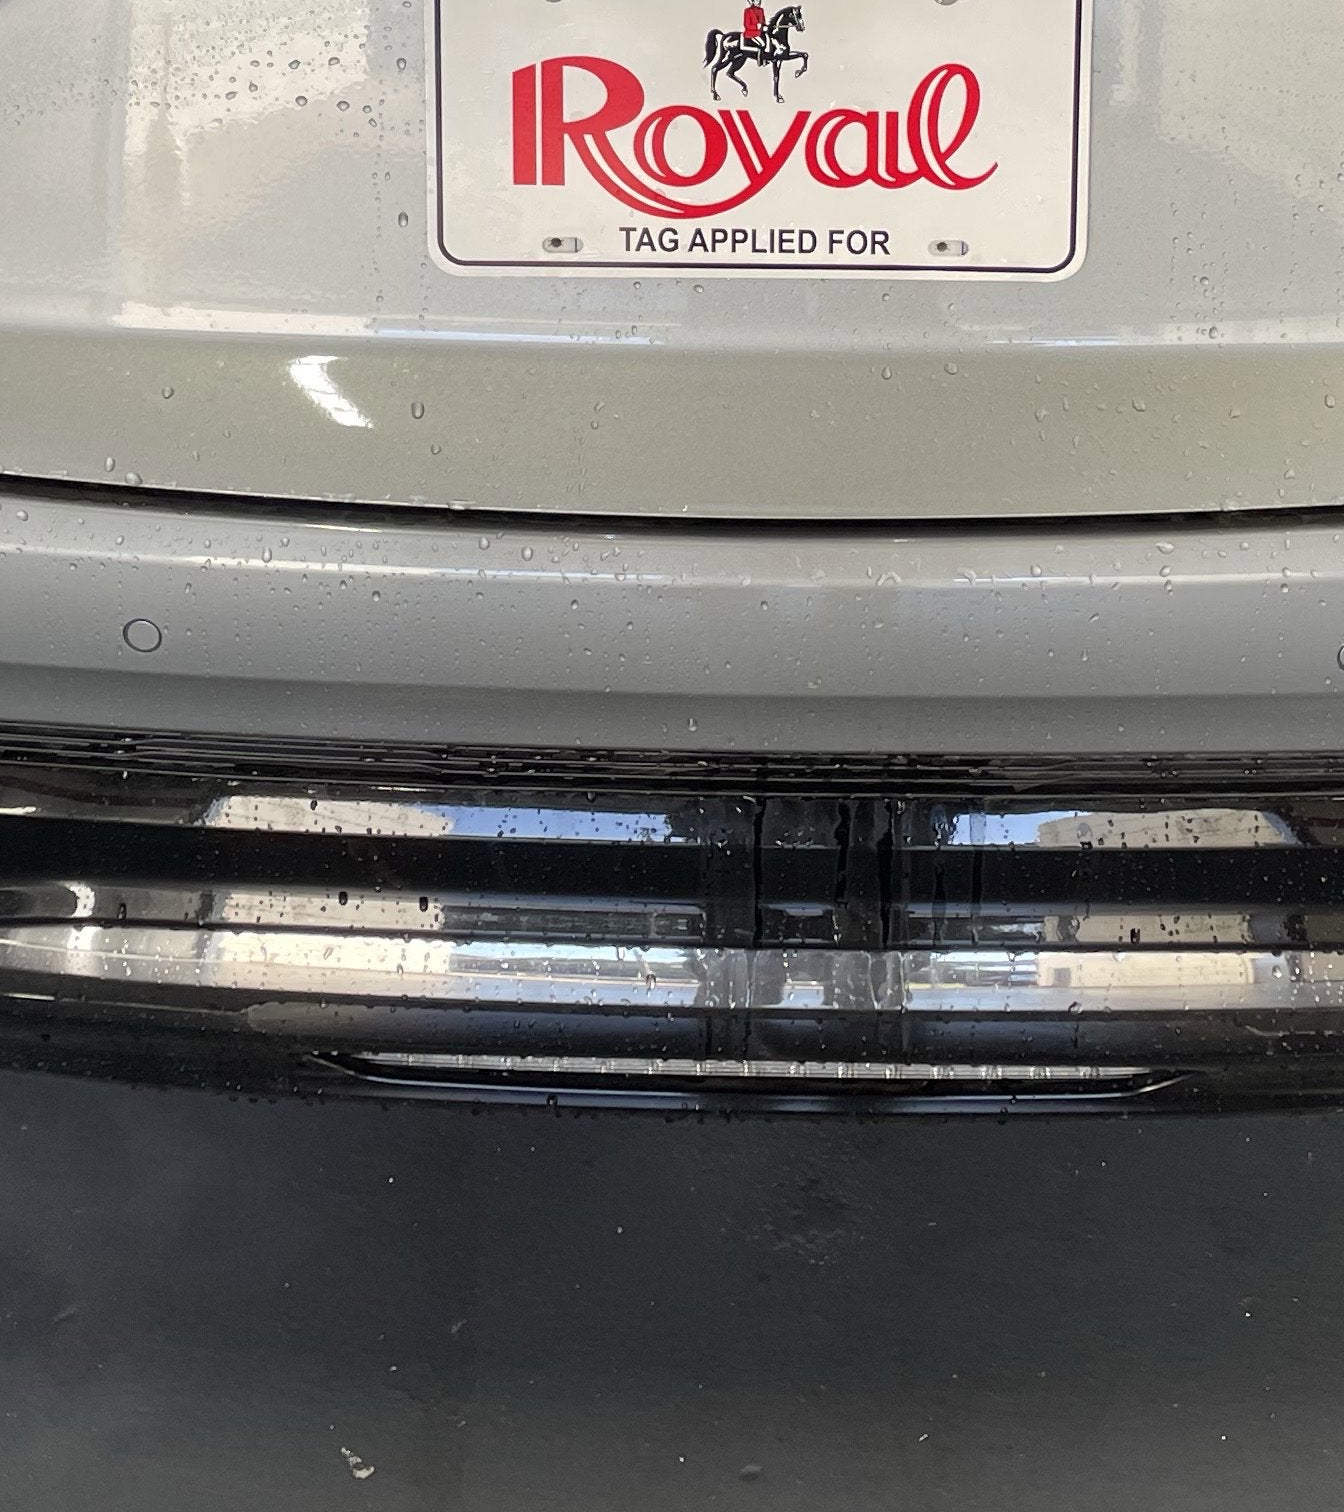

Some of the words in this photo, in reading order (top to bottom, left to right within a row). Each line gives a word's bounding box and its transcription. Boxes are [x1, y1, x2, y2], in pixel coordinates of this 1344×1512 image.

[512, 56, 999, 219] Royal
[619, 226, 680, 254] TAG
[687, 228, 818, 255] APPLIED
[828, 230, 890, 256] FOR
